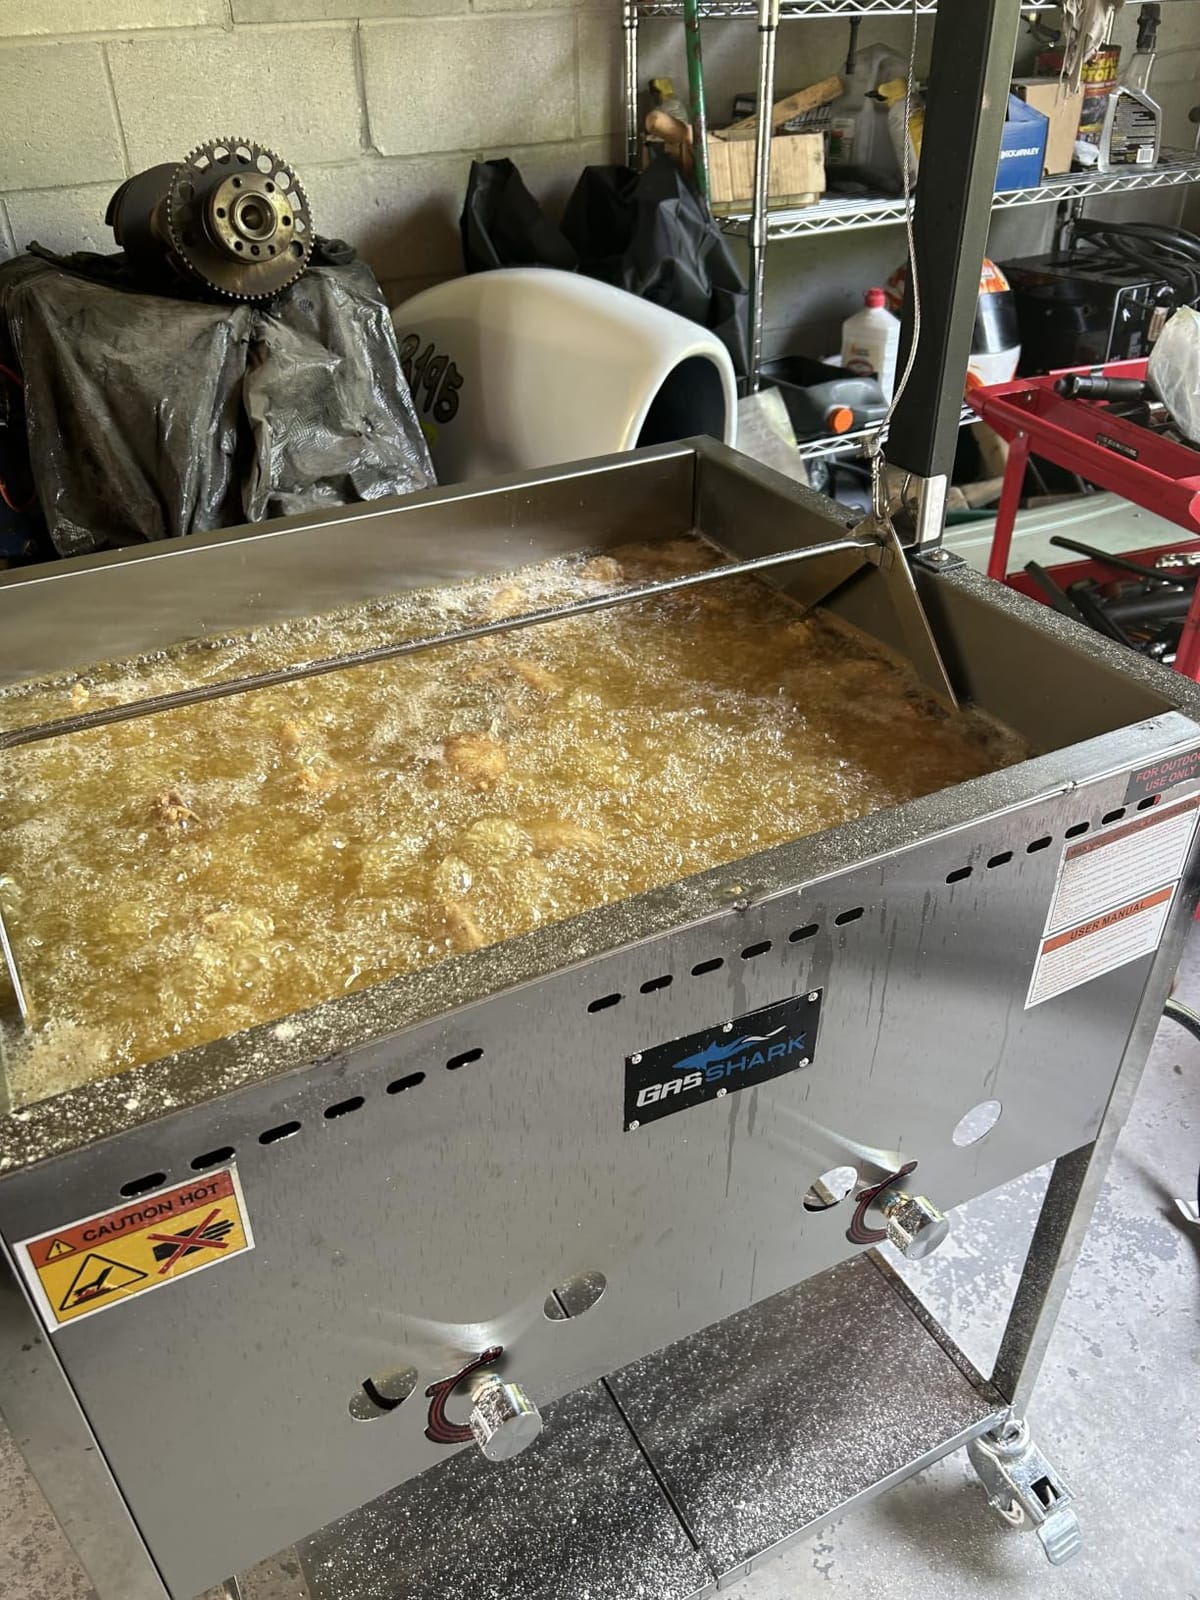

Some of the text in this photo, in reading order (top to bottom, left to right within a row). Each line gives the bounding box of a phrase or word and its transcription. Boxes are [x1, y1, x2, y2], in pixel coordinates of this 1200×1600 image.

[1135, 767, 1159, 783] FOR
[1145, 765, 1197, 792] USE ONLY
[1070, 901, 1145, 939] USER MANUAL
[82, 1182, 219, 1243] CAUTION HOT
